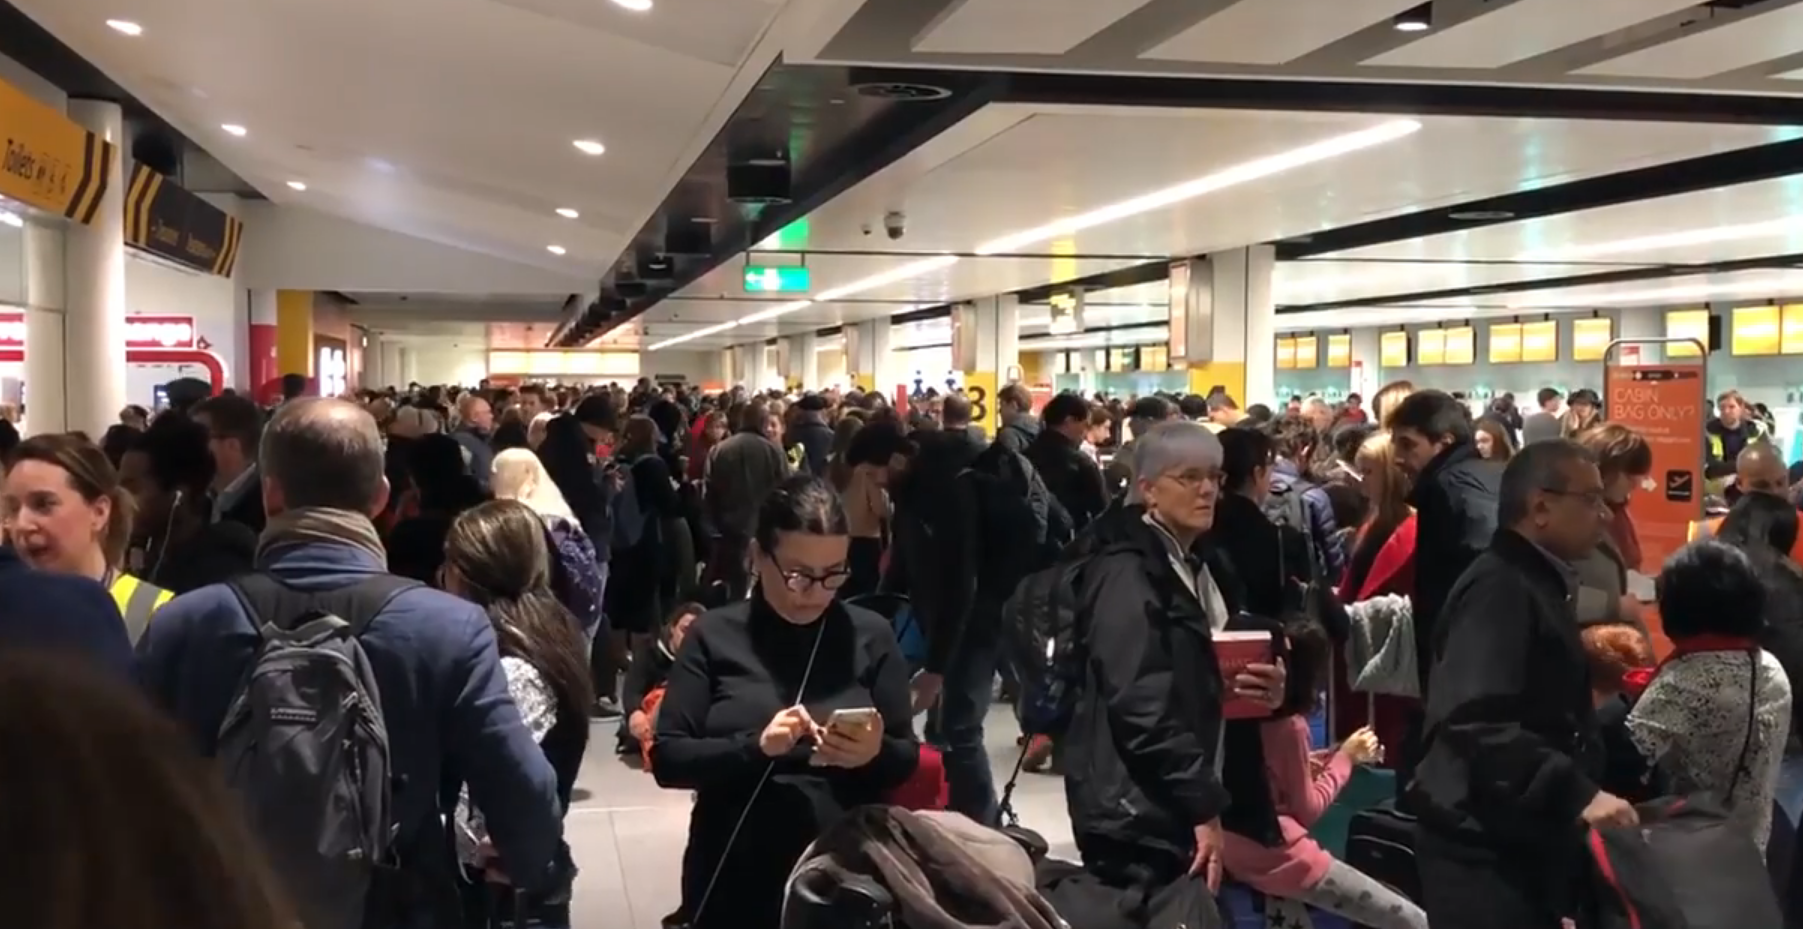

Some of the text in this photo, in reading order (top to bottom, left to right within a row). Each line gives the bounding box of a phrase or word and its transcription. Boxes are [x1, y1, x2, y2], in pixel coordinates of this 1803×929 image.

[3, 138, 35, 180] Toilets
[1615, 388, 1659, 403] CABIN
[1615, 404, 1694, 420] BAG ONLY?
